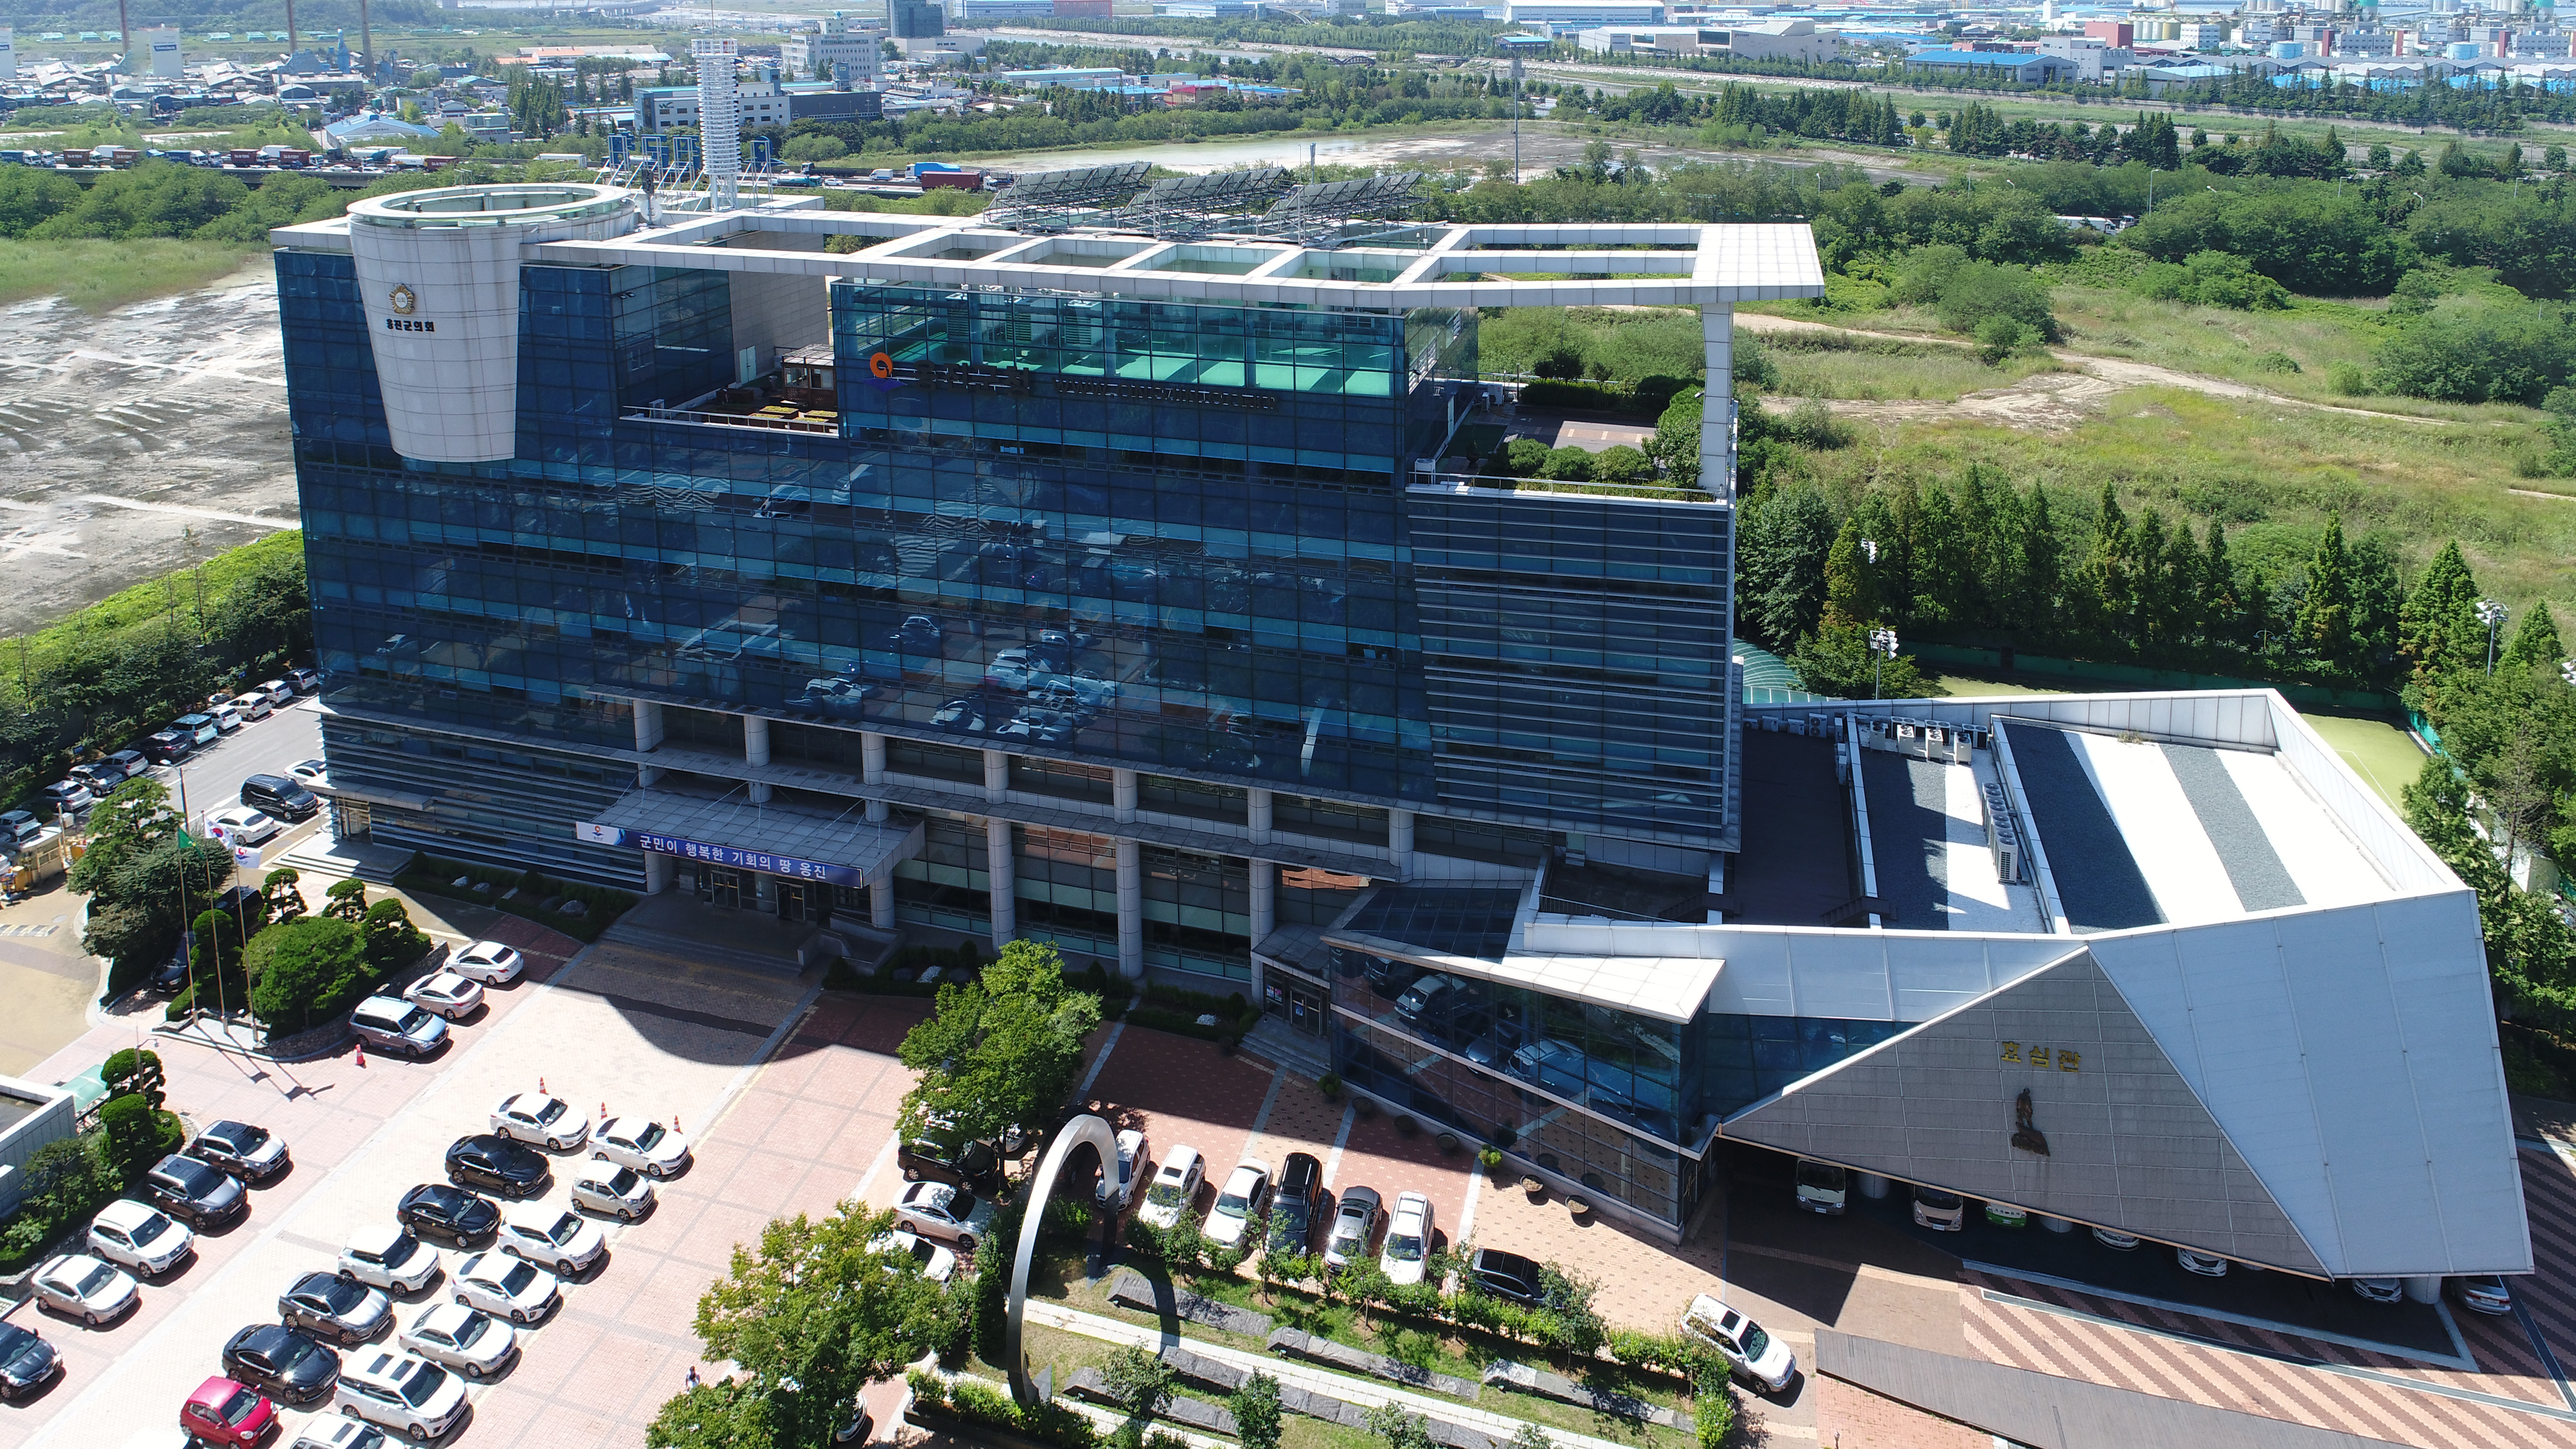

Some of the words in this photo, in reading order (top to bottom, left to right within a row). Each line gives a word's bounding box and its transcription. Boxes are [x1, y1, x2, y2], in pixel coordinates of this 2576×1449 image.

[386, 318, 435, 332] 옹진군의회
[913, 360, 1030, 396] 옹진군청
[639, 835, 678, 855] 군민이
[685, 843, 724, 862] 행복한
[733, 850, 771, 870] 기회의
[780, 859, 792, 873] 땅
[800, 862, 826, 880] 옹진
[2001, 1041, 2081, 1072] 효심관
